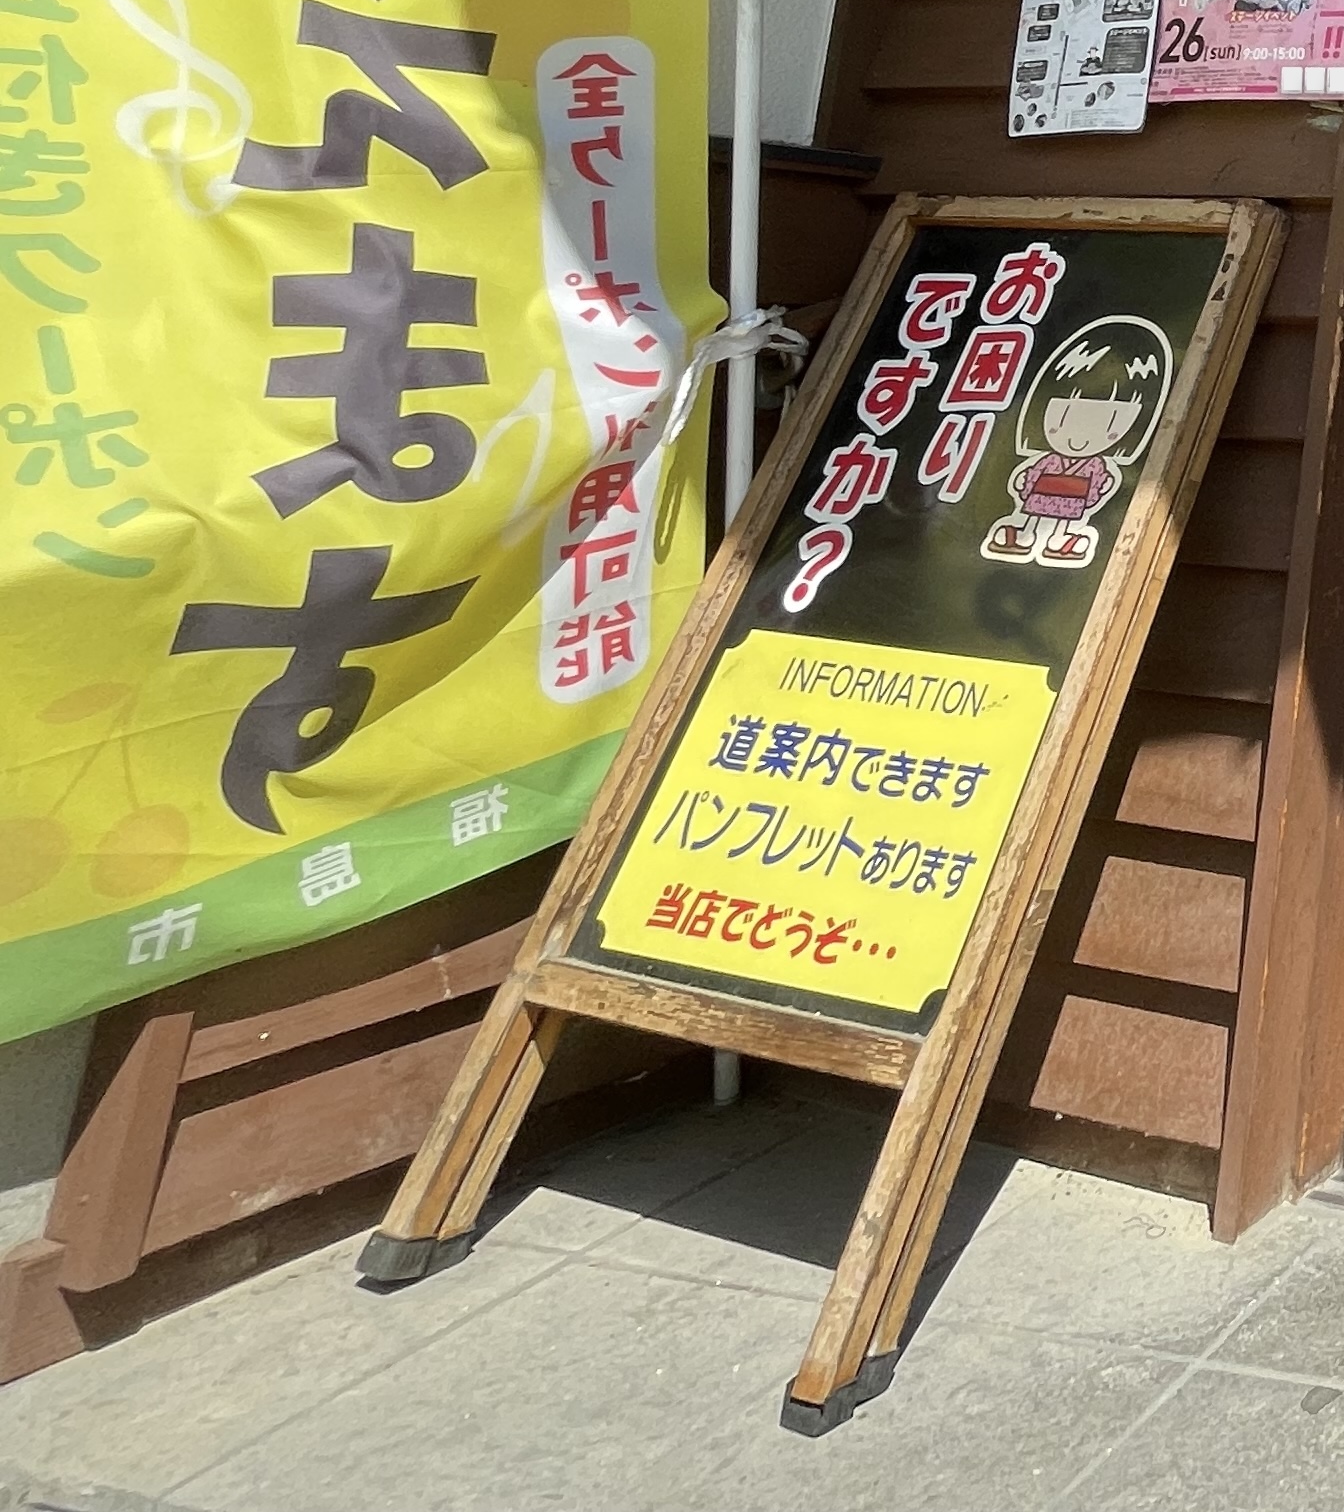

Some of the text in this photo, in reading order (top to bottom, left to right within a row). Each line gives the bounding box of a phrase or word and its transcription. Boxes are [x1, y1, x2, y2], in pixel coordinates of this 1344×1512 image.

[1158, 16, 1206, 64] 26
[920, 242, 1065, 503] お困り
[783, 272, 976, 612] ですか?
[779, 656, 989, 718] INFORMATION
[709, 713, 990, 810] 道案内できます
[653, 789, 977, 899] パンフレットあります
